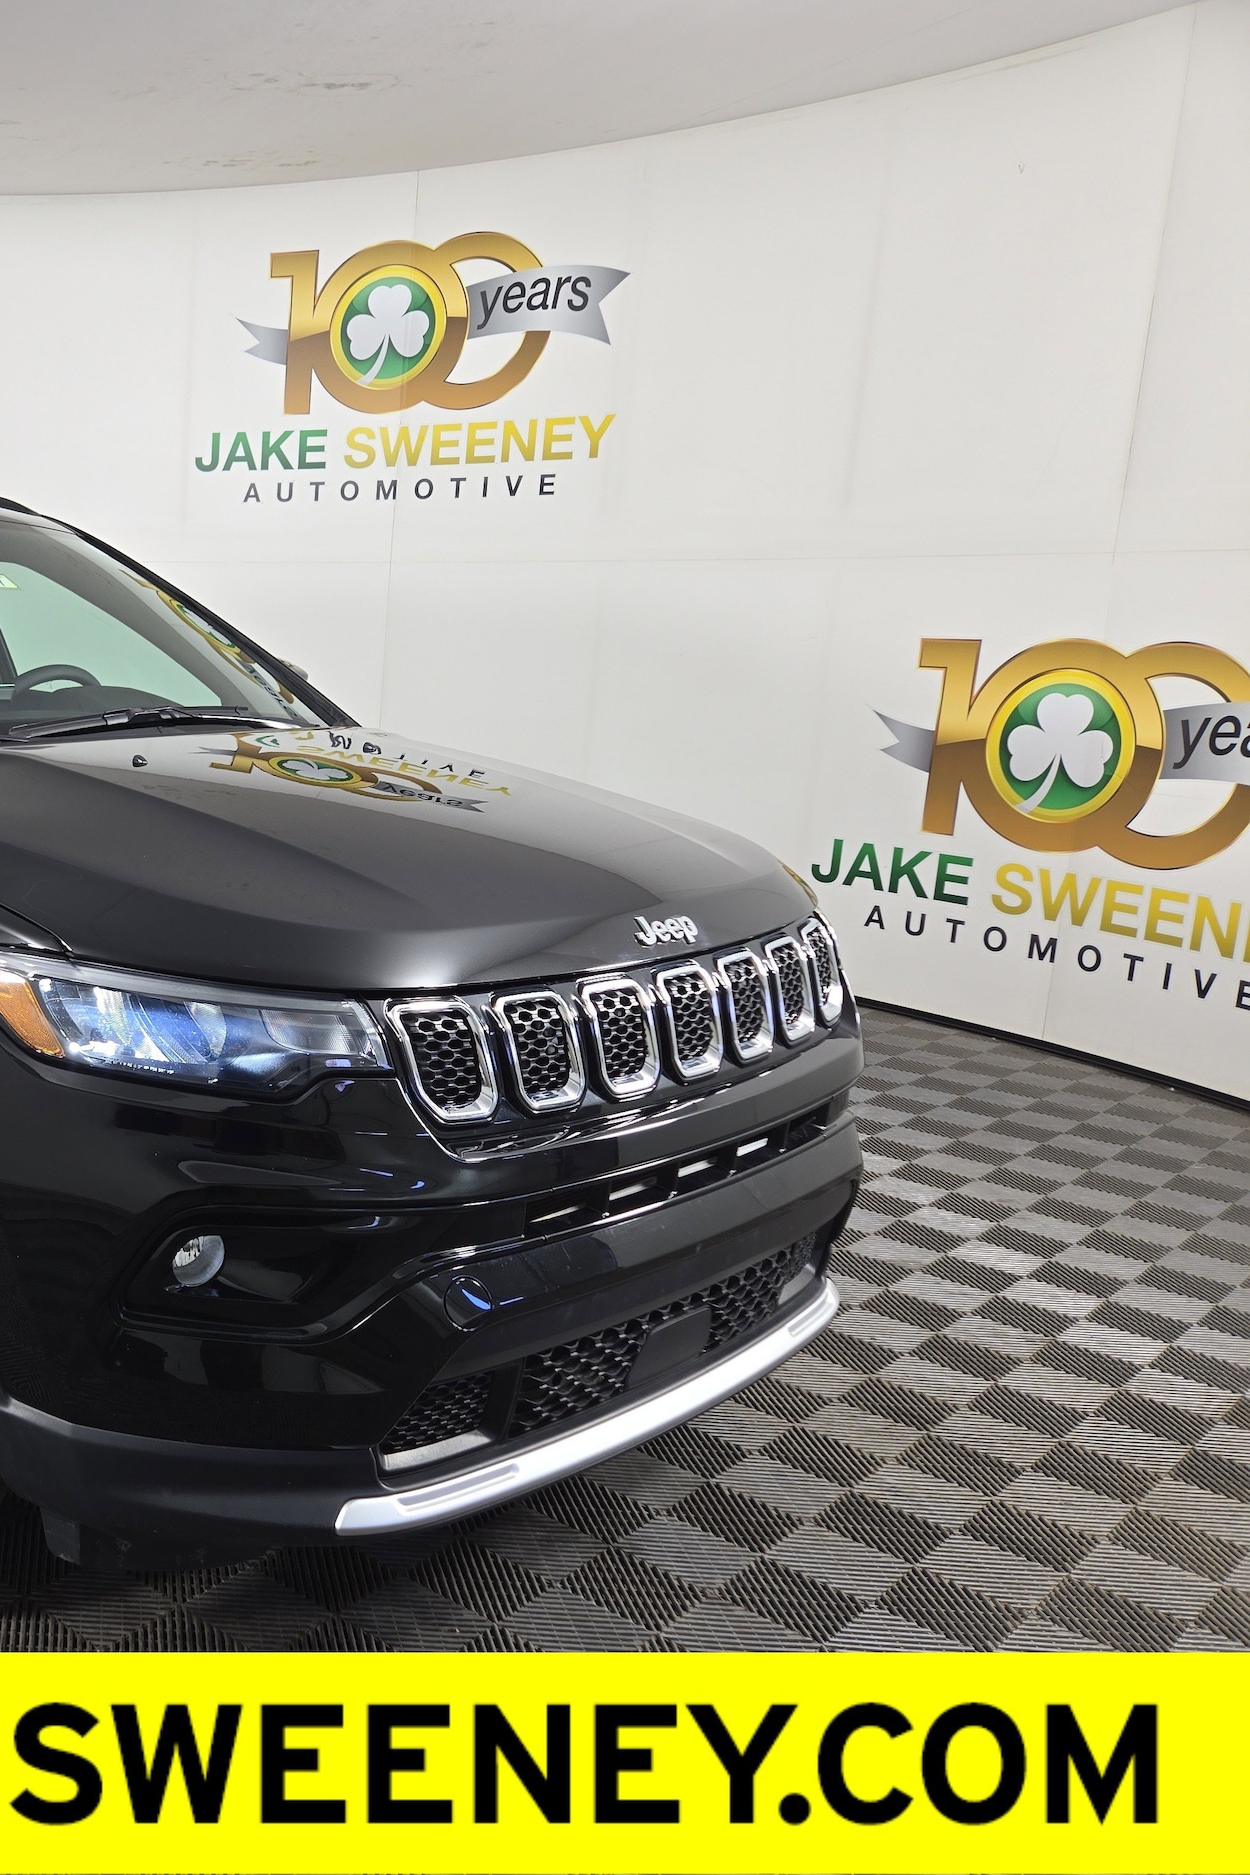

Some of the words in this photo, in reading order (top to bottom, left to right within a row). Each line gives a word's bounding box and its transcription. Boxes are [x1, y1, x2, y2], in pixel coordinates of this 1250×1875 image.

[270, 231, 551, 415] 100
[476, 274, 592, 331] years
[194, 428, 329, 473] JAKE
[343, 413, 617, 469] SWEENEY
[243, 473, 557, 504] AUTOMOTIVE
[811, 838, 975, 906] JAKE
[991, 863, 1250, 963] SWEEN
[634, 915, 699, 947] Jeep
